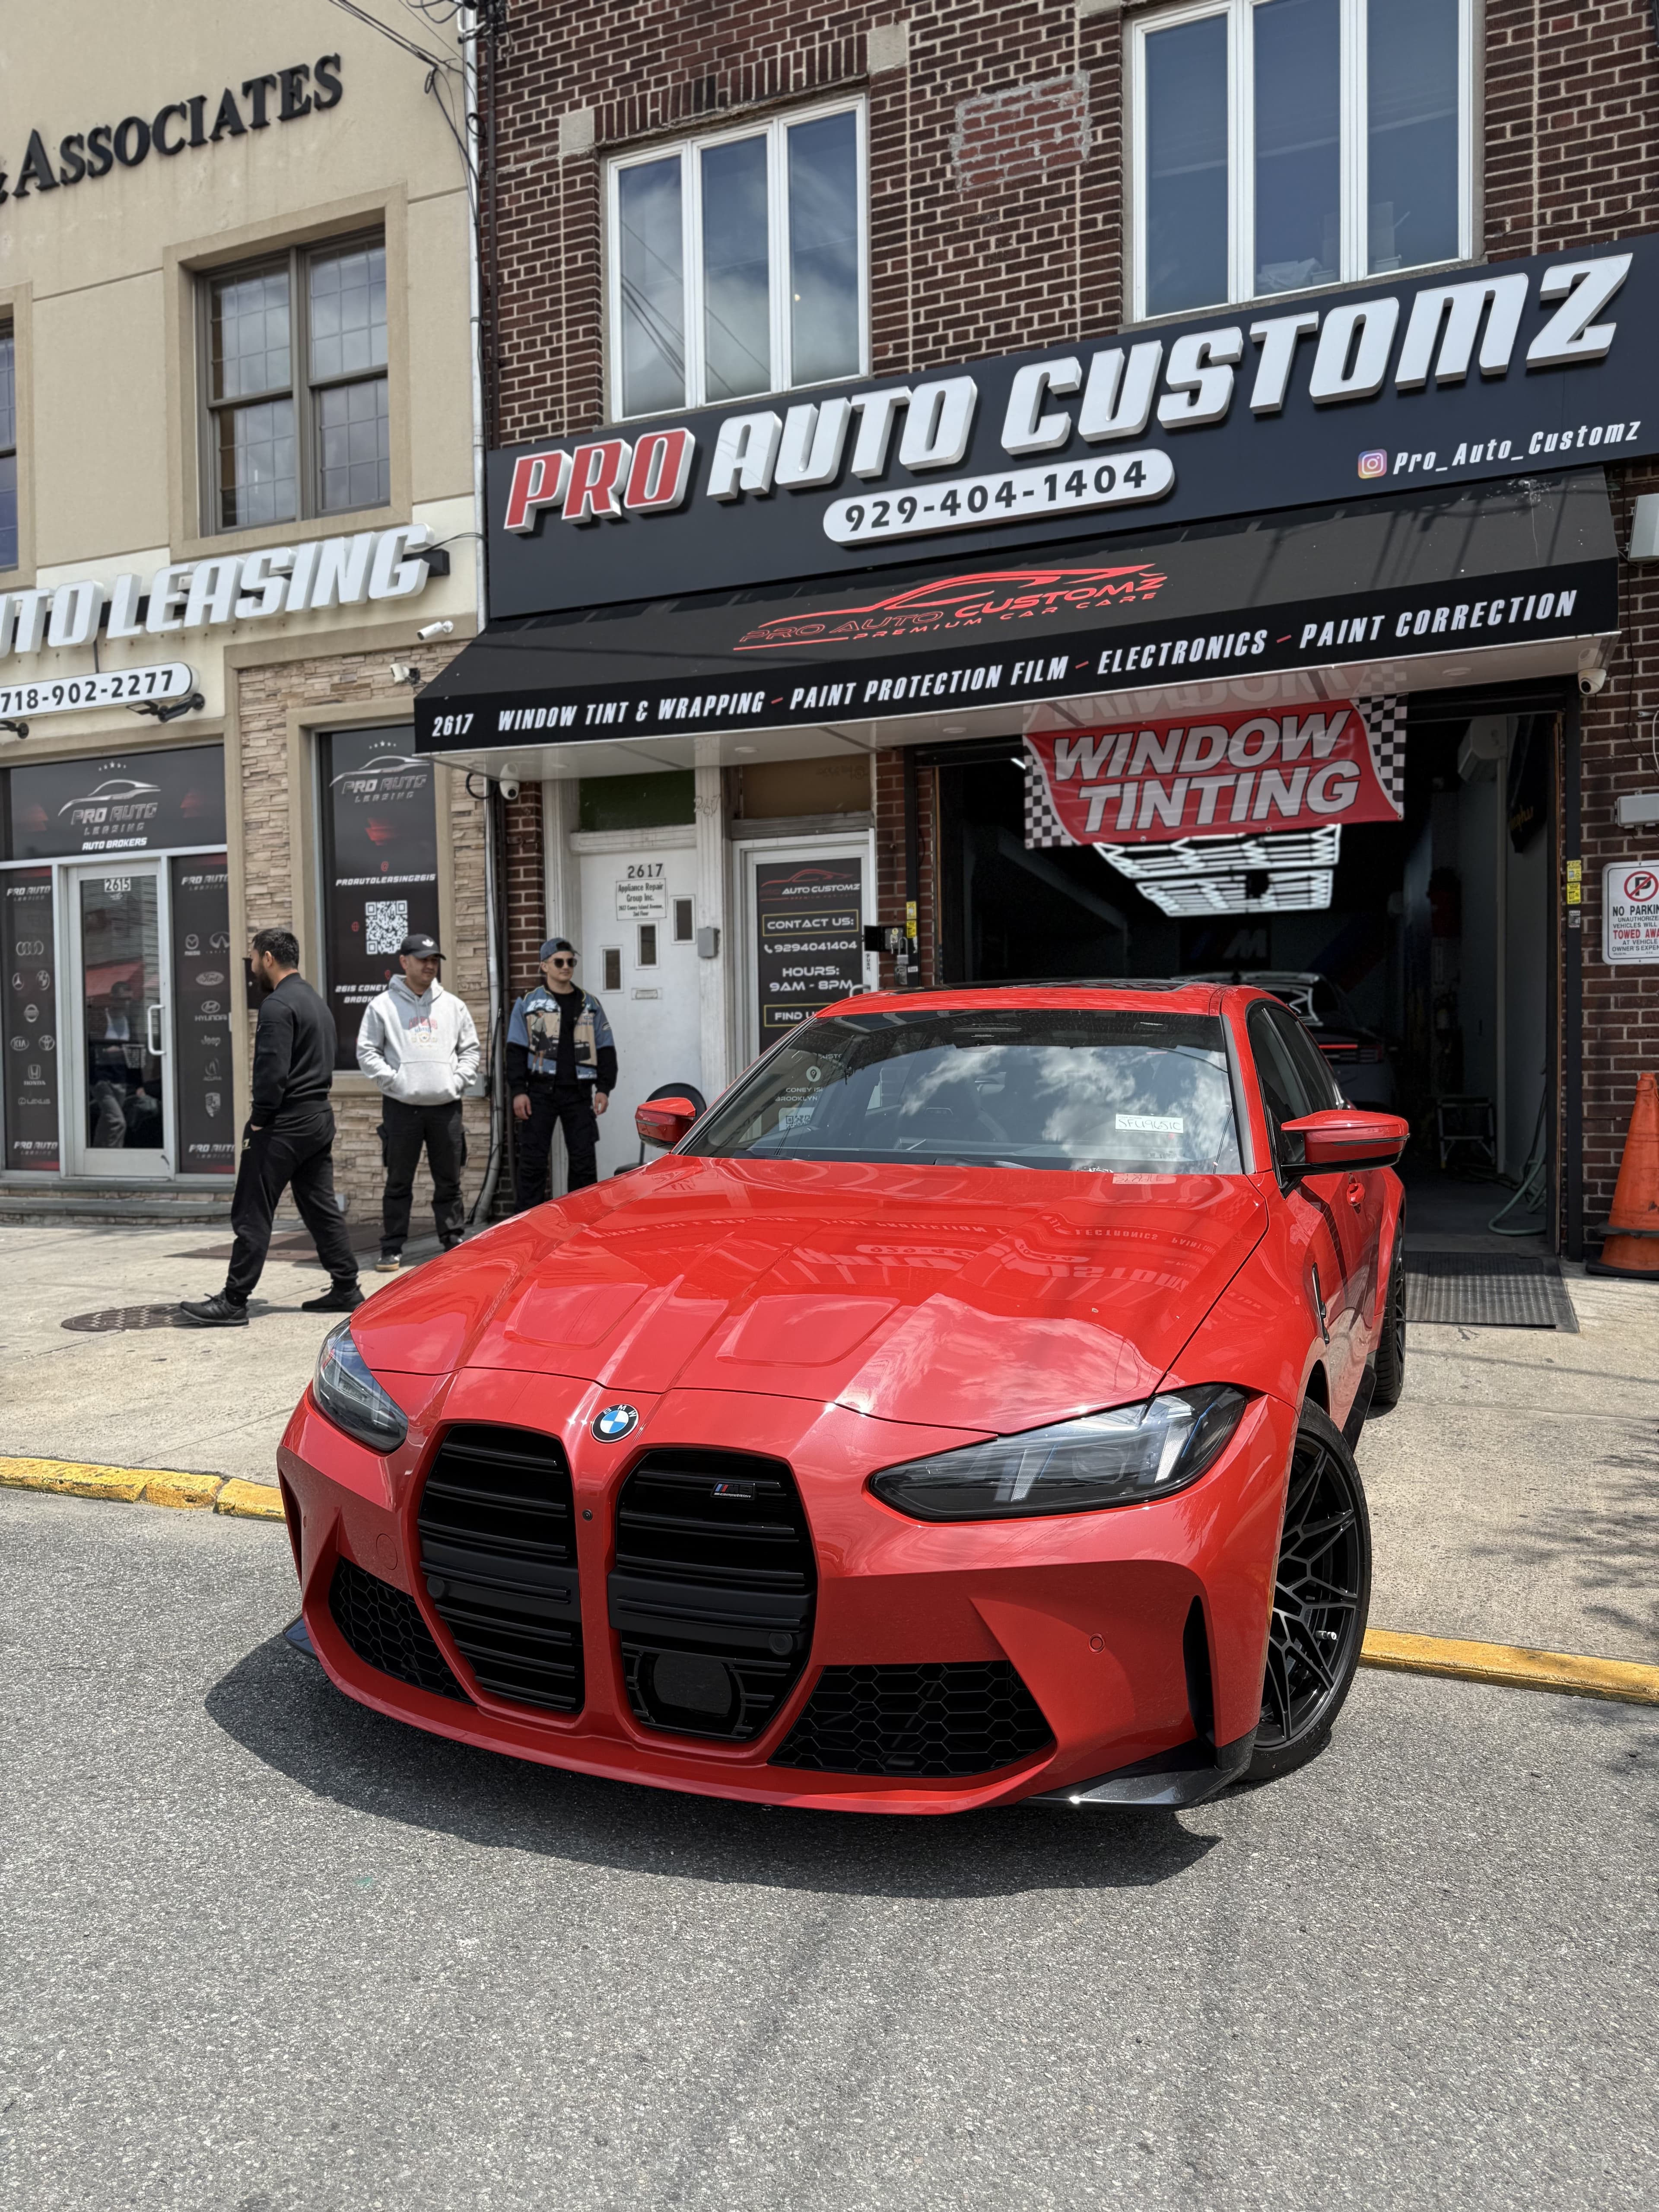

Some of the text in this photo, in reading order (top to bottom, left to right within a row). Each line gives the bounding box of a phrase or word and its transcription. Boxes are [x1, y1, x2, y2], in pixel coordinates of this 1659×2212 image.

[12, 53, 343, 197] ASSOCIATES
[504, 253, 1633, 533] PRO AUTO CUSTOMZ
[1393, 420, 1641, 475] Pro_Auto_Customz
[845, 461, 1147, 532] 929-404-1404
[107, 523, 435, 639] LEASING
[739, 576, 1168, 642] PRO AUTO CUSTOMZ
[852, 593, 1156, 640] PREMIUM CAR CARE
[432, 714, 474, 737] 2617
[498, 706, 578, 731] WINDOW
[585, 701, 629, 725] TINT
[636, 700, 648, 721] &
[658, 691, 766, 720] WRAPPING
[790, 681, 856, 709] PAINT
[864, 665, 1002, 702] PROTECTION
[1011, 655, 1069, 686] FILM
[1097, 628, 1268, 675] ELECTRONICS
[1300, 614, 1386, 649] PAINT
[1395, 589, 1578, 638] CORRECTION
[0, 670, 173, 713] 718-902-2277
[1053, 709, 1355, 782] WINDOW
[341, 775, 427, 794] PRO AUTO
[1078, 760, 1361, 833] TINTING
[70, 802, 158, 825] PRO AUTO
[84, 822, 145, 836] LEASING
[82, 837, 148, 850] AUTO BROKERS
[628, 863, 664, 879] 2617
[105, 877, 130, 891] 2615
[618, 882, 664, 894] Appliance Repair
[782, 887, 810, 895] AUTO
[811, 884, 861, 893] CUSTOMZ
[626, 893, 654, 903] Group Inc.
[1613, 906, 1624, 916] NO
[767, 918, 854, 929] CONTACT US:
[1613, 929, 1641, 940] TOWED
[774, 941, 858, 952] 9294041404
[782, 966, 839, 977] HOURS:
[769, 981, 806, 992] 9AM
[818, 979, 853, 990] 8PM
[775, 1012, 803, 1020] FIND
[603, 1404, 637, 1418] BMW
